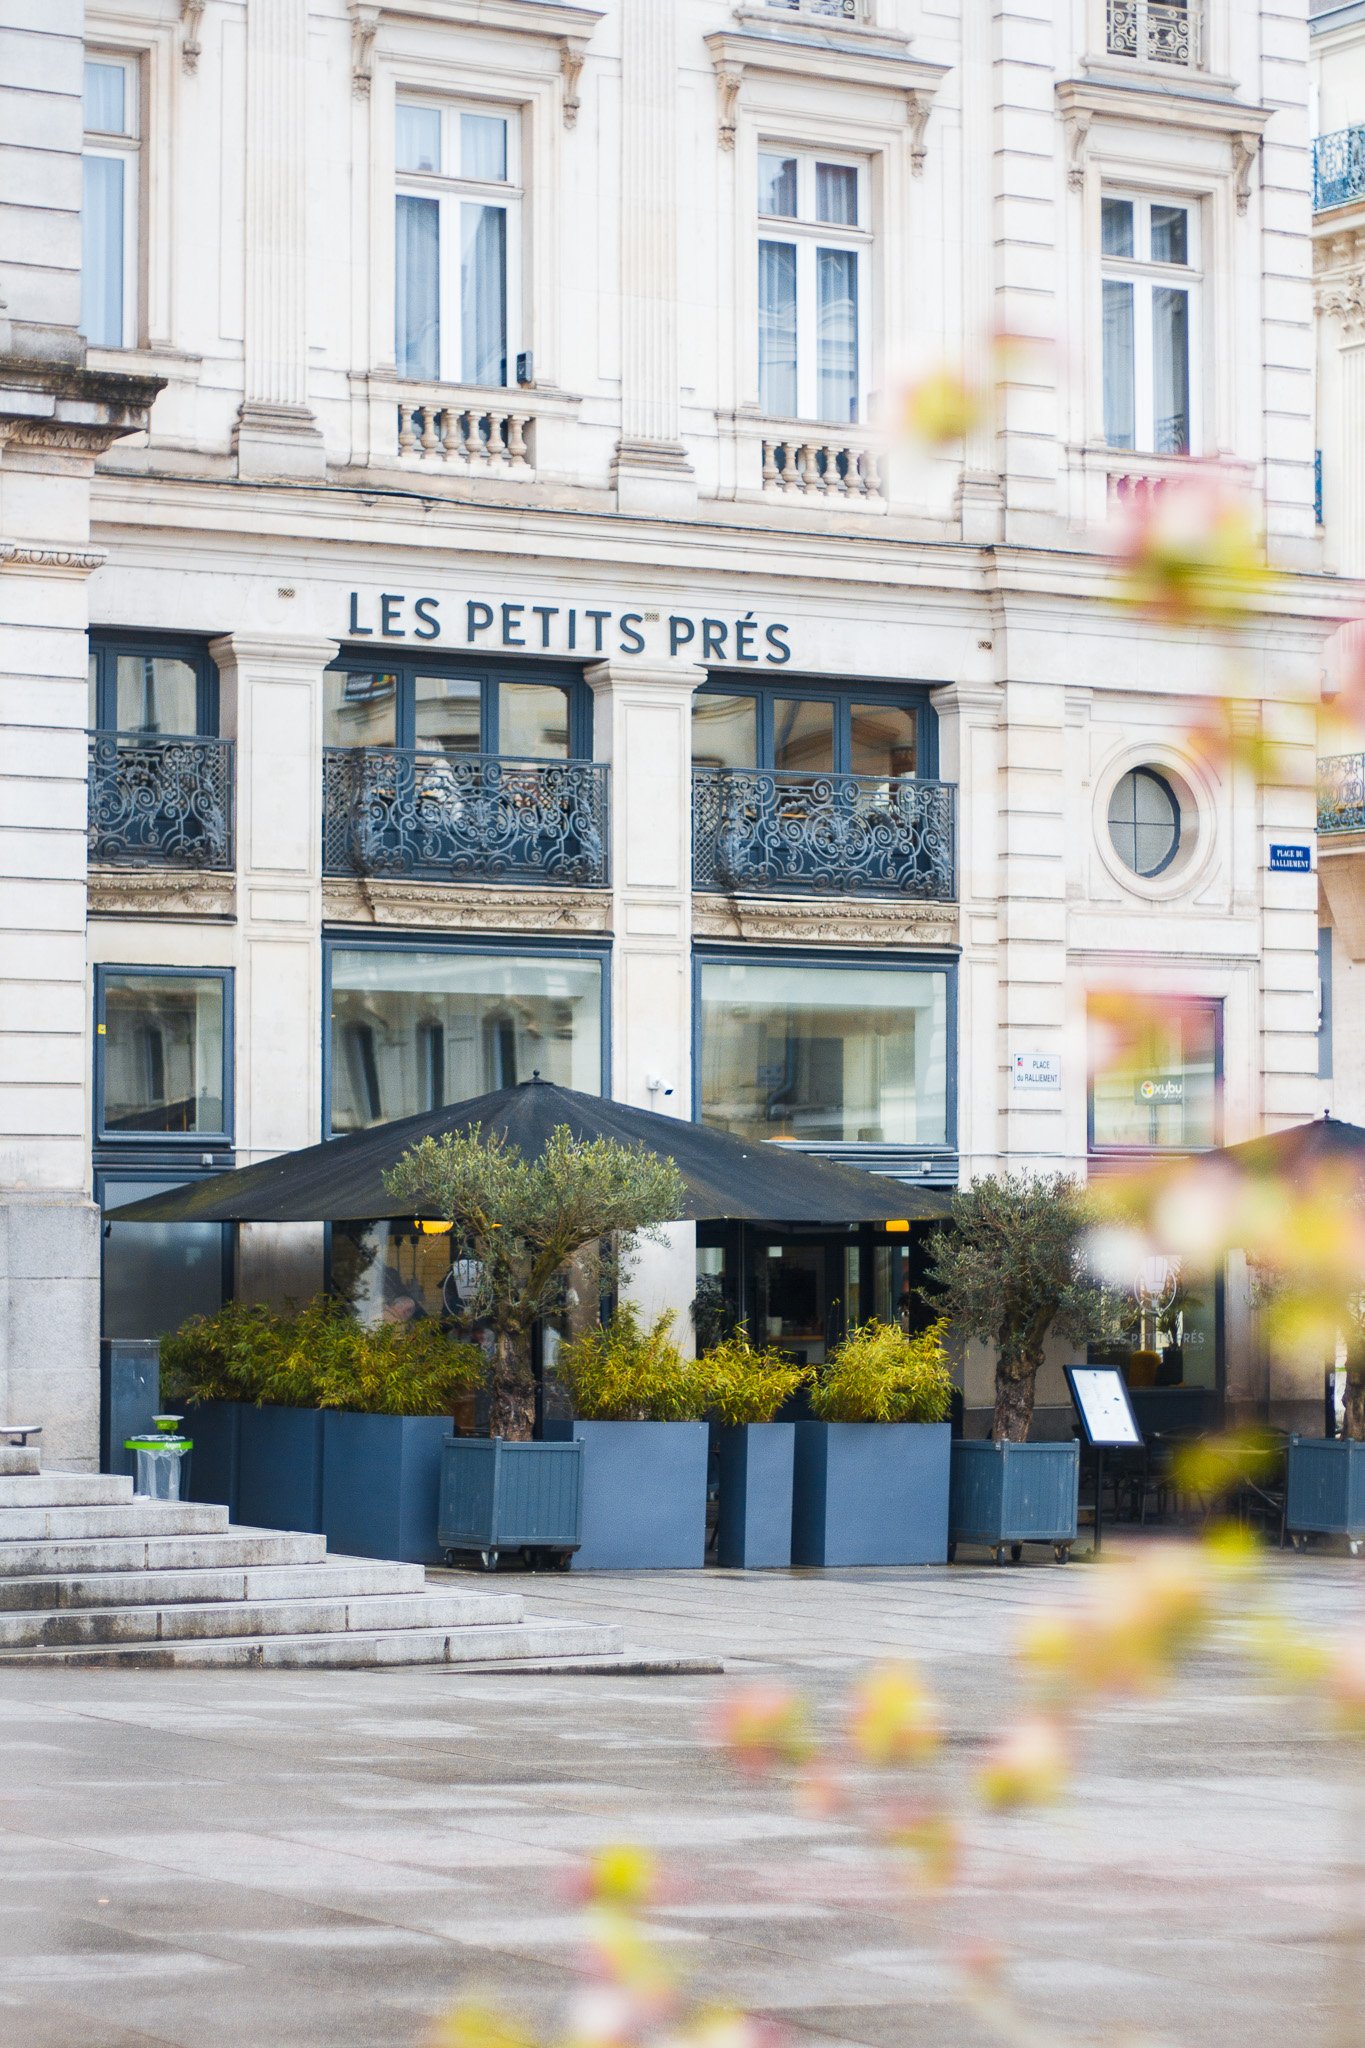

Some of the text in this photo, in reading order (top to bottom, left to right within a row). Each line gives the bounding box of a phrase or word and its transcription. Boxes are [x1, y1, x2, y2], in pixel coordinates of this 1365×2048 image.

[349, 592, 792, 664] LES PETITS PRÉS
[1276, 849, 1294, 857] PLACE
[1271, 858, 1309, 868] RALLIEMENT
[1032, 1060, 1050, 1069] PLACE
[1016, 1073, 1058, 1083] du RALLIEMENT
